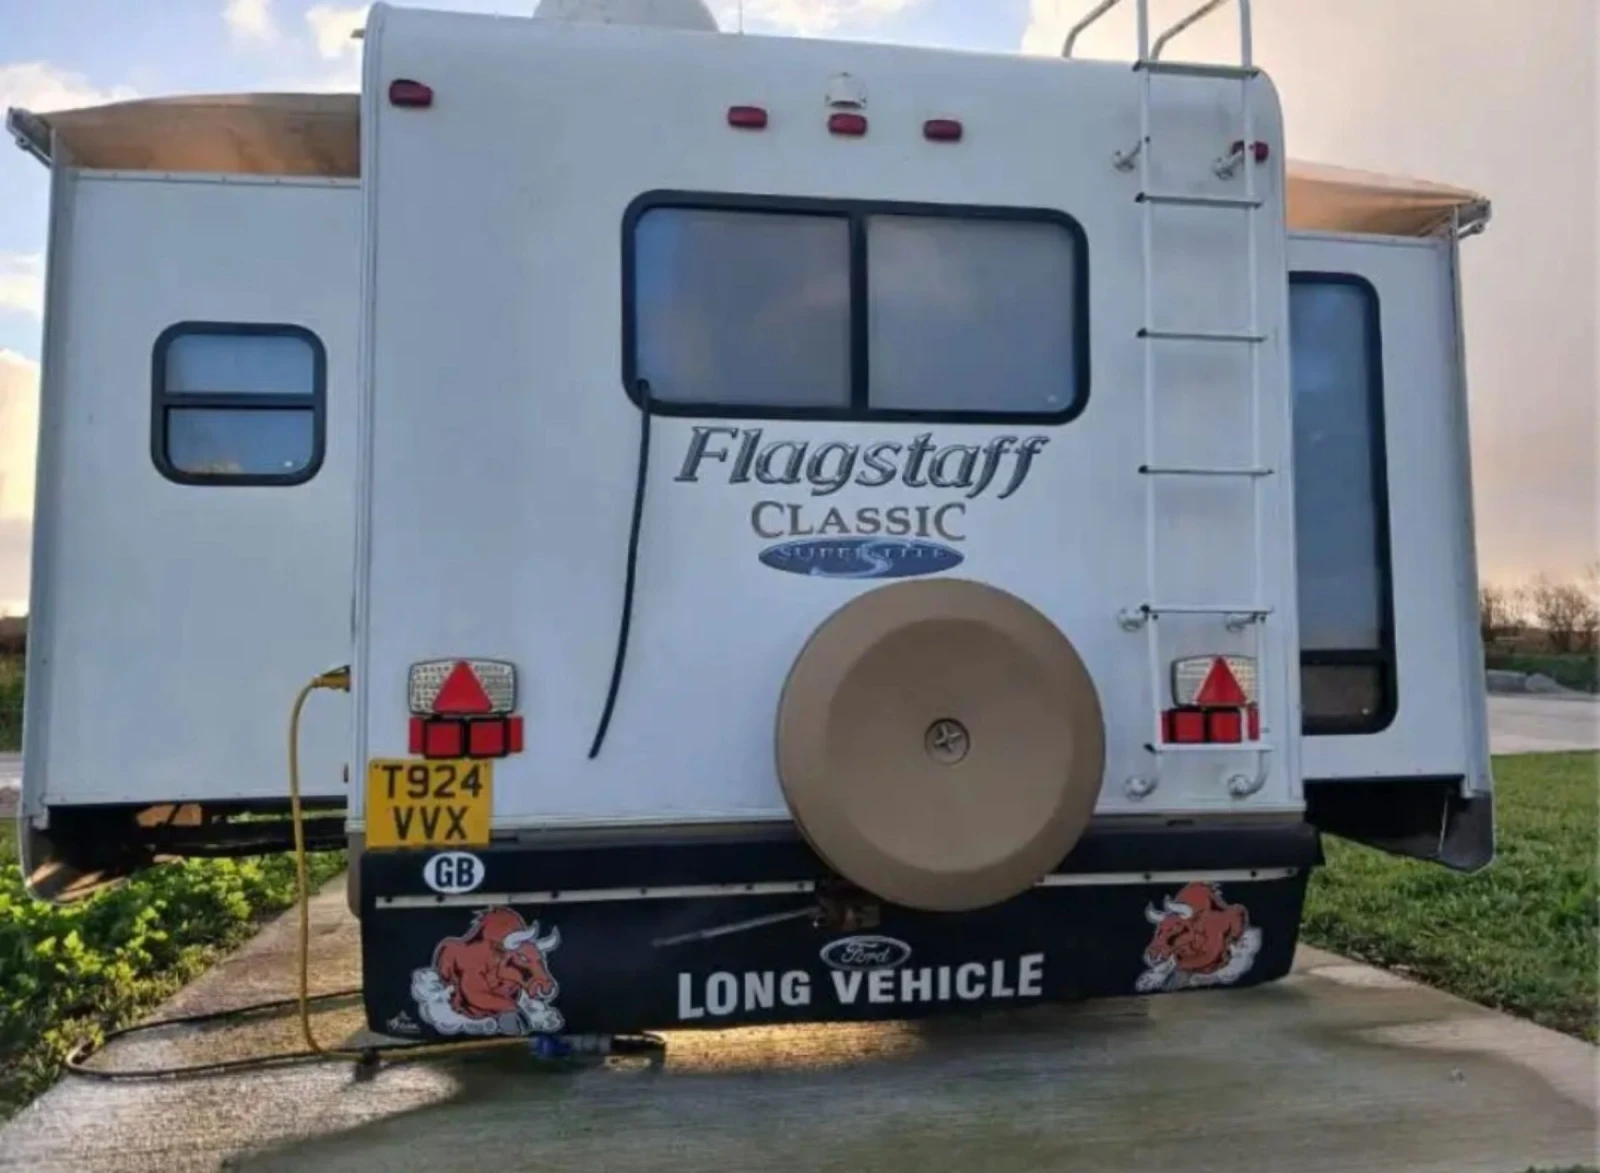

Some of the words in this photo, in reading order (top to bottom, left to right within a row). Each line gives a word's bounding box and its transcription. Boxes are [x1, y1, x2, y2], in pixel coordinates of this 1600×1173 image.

[673, 425, 1051, 499] Flagstaff
[750, 501, 967, 541] CLASSIC
[381, 764, 483, 799] T924
[393, 805, 469, 840] VVX
[434, 857, 476, 888] GB
[841, 942, 891, 964] Ford
[678, 970, 812, 1020] LONG
[830, 953, 1046, 1005] VEHICLE
